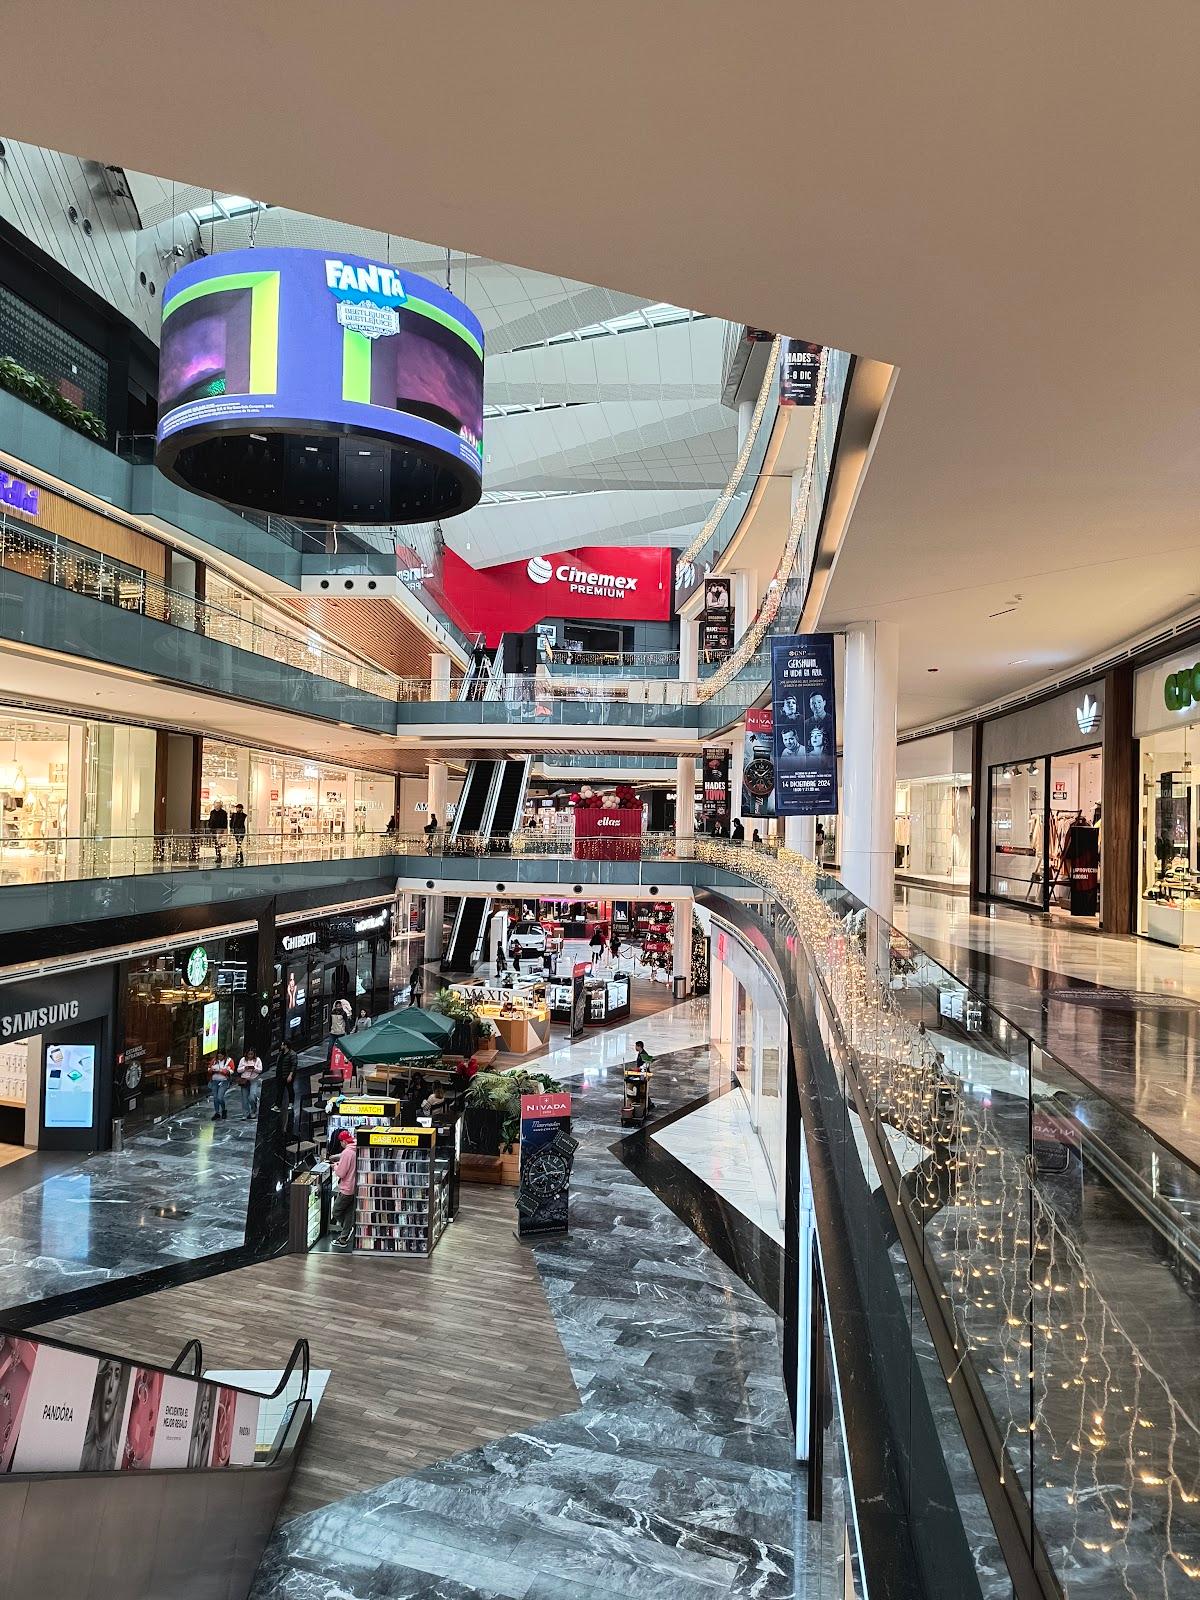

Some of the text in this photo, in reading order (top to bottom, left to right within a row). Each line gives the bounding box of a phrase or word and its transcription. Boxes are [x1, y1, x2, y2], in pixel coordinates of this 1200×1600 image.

[324, 259, 406, 298] FANTA
[799, 370, 812, 381] DIC
[555, 565, 639, 591] Cinemex
[569, 584, 625, 599] PREMIUM
[704, 781, 726, 790] HADES
[705, 790, 726, 801] TOWN
[2, 1000, 79, 1037] SAMSUNG
[526, 1103, 567, 1111] NIVADA
